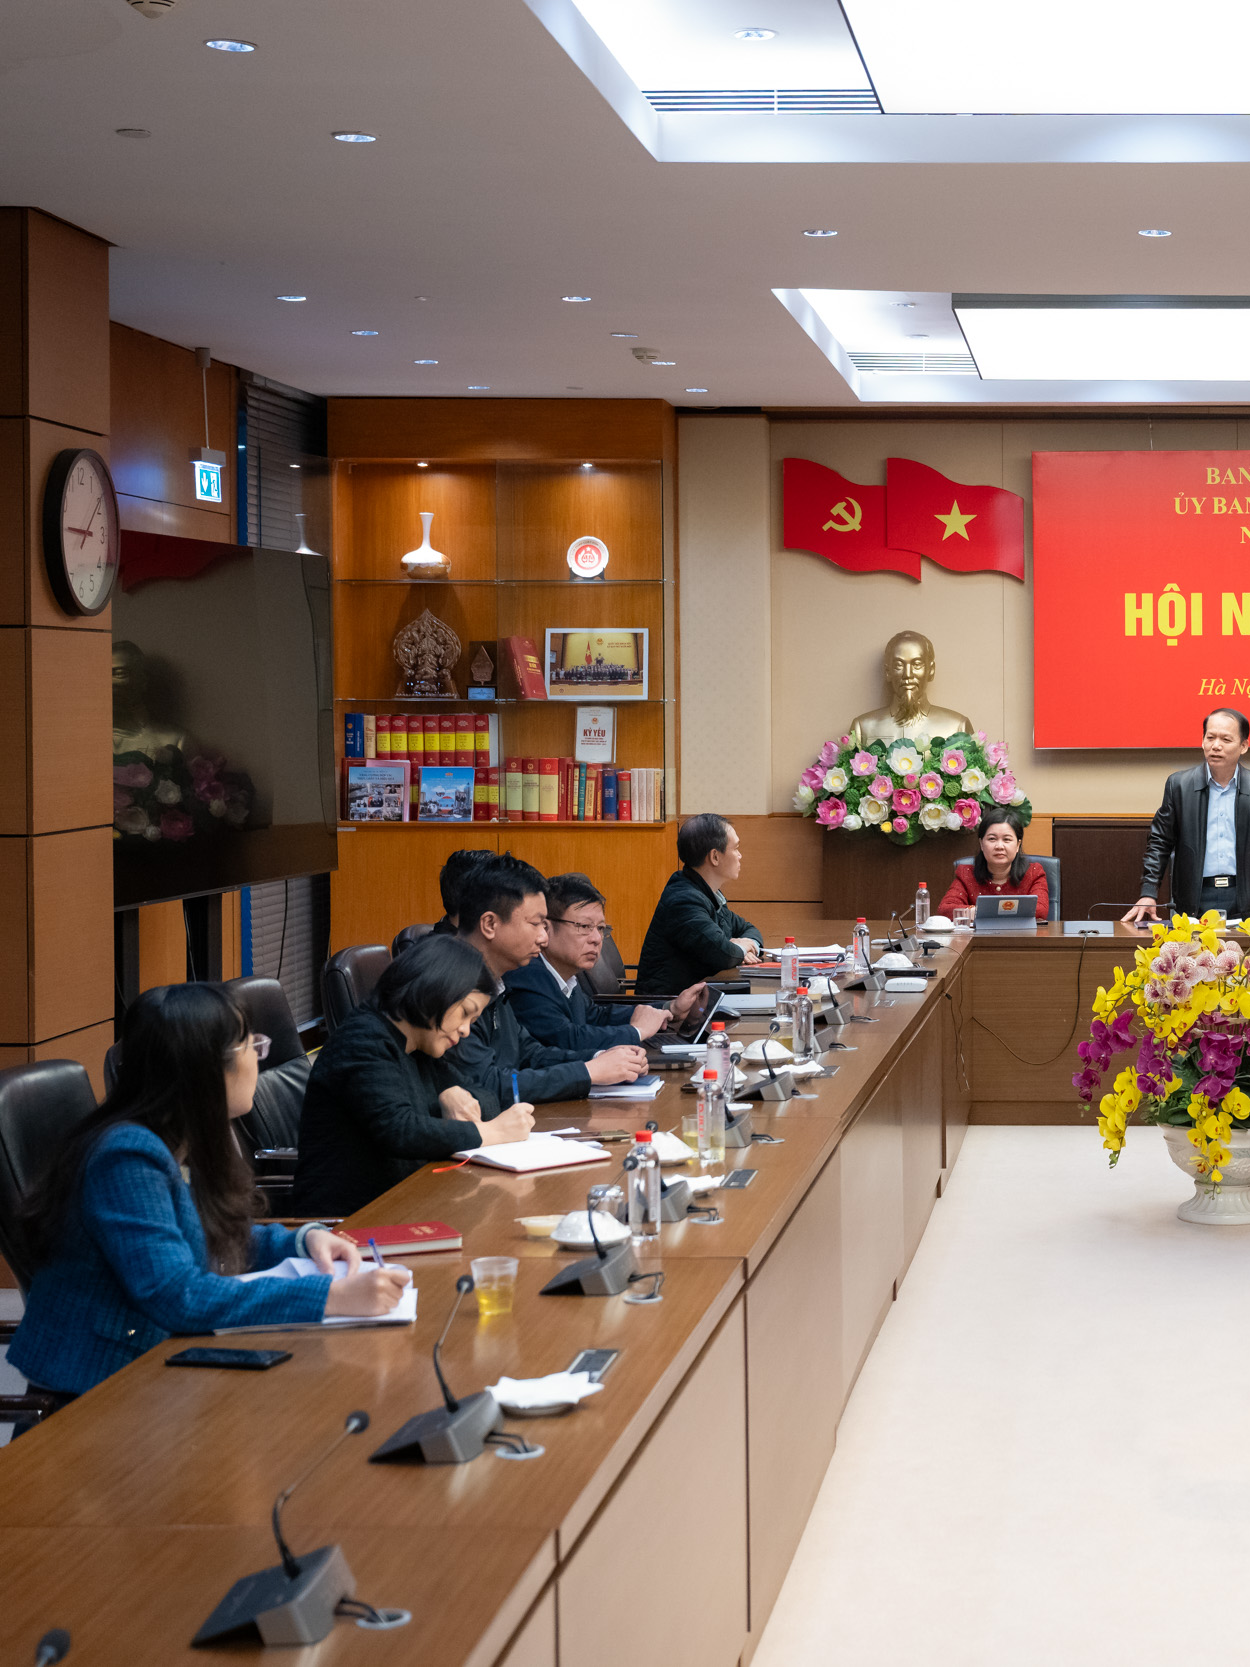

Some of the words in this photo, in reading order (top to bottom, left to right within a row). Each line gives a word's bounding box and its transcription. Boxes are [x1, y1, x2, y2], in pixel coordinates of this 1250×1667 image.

[77, 467, 85, 486] 12
[1174, 491, 1207, 515] ỦY
[100, 526, 105, 545] 3
[79, 580, 84, 598] 6
[89, 574, 95, 592] 5
[1124, 582, 1203, 646] HỘI
[1198, 677, 1227, 696] Hà
